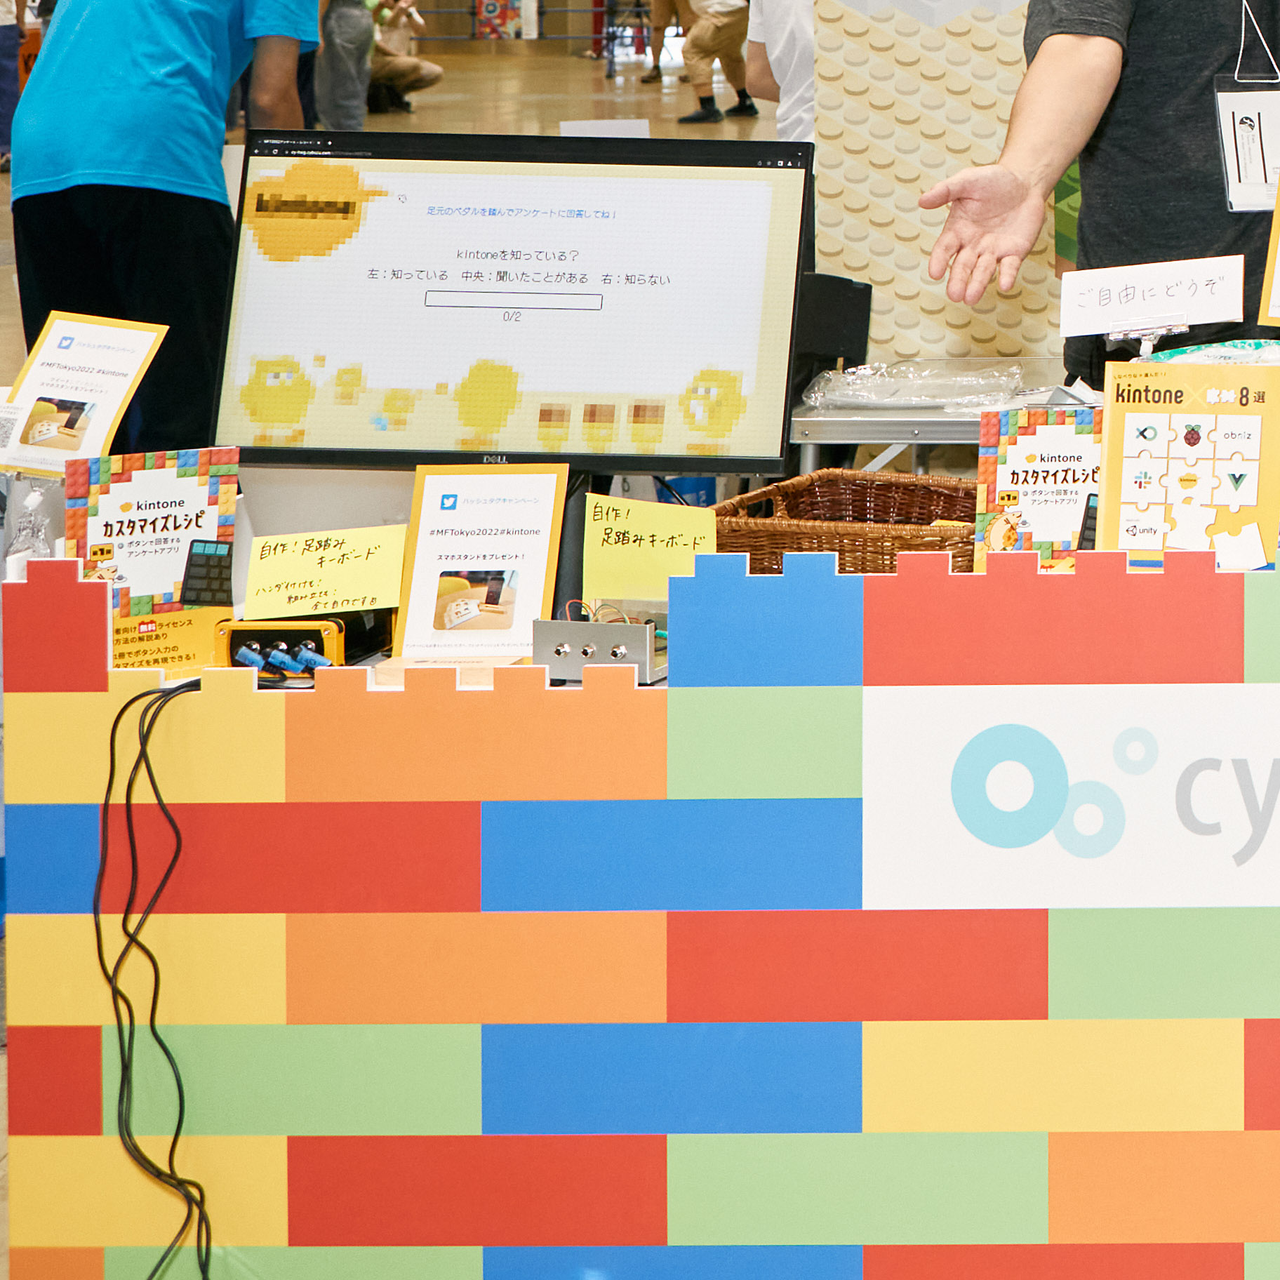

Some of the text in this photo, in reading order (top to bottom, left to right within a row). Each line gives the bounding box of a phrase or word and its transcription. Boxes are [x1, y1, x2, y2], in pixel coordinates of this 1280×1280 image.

[1078, 276, 1225, 308] ご自由にどうぞ
[503, 310, 522, 323] 0/2
[40, 361, 129, 378] #MFTokyo2022 #kintone
[1115, 383, 1184, 404] kintone
[1223, 431, 1252, 440] obniz
[483, 455, 508, 464] DELL
[1039, 453, 1083, 463] kintone
[1010, 465, 1100, 485] カスタマイズレシピ
[1030, 489, 1079, 497] ボタンで回答する
[136, 499, 185, 511] kintone
[1030, 498, 1078, 506] アンケートアプリ
[103, 510, 206, 538] カスタマイズレシピ
[1138, 526, 1158, 535] unity
[126, 537, 181, 548] ボタンで回答する
[601, 527, 706, 551] 足踏みキーボード
[126, 547, 180, 558] アンケートアプリ
[316, 545, 381, 568] キーボード
[437, 553, 526, 561] スマホスタンドをプレゼント！
